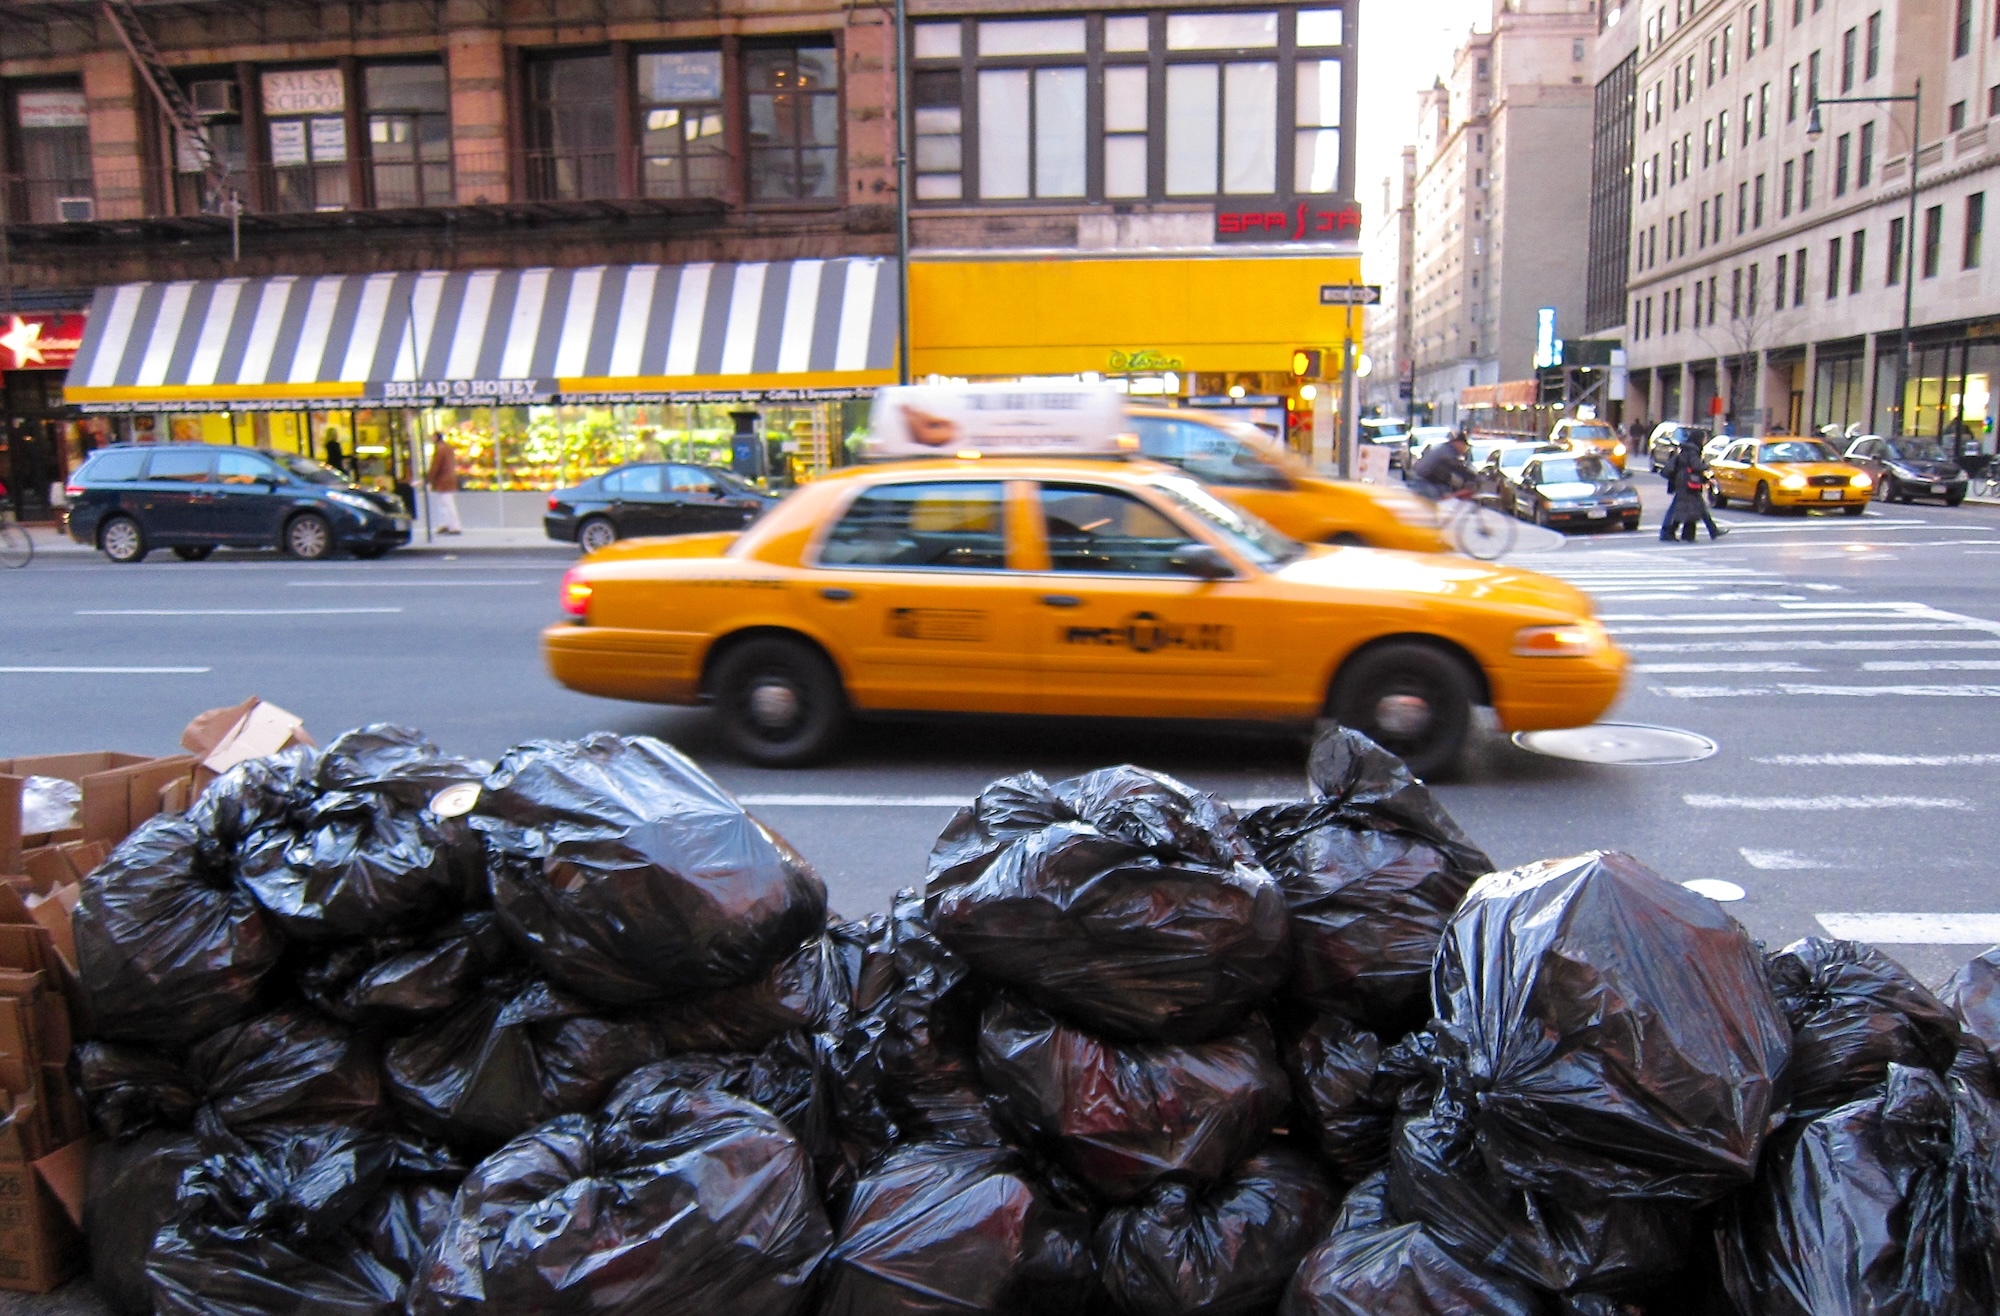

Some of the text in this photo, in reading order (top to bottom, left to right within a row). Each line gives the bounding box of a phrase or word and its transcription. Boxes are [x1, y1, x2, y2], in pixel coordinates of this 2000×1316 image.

[270, 74, 339, 91] SALSA
[1218, 211, 1287, 233] SPA
[471, 380, 538, 395] HONEY
